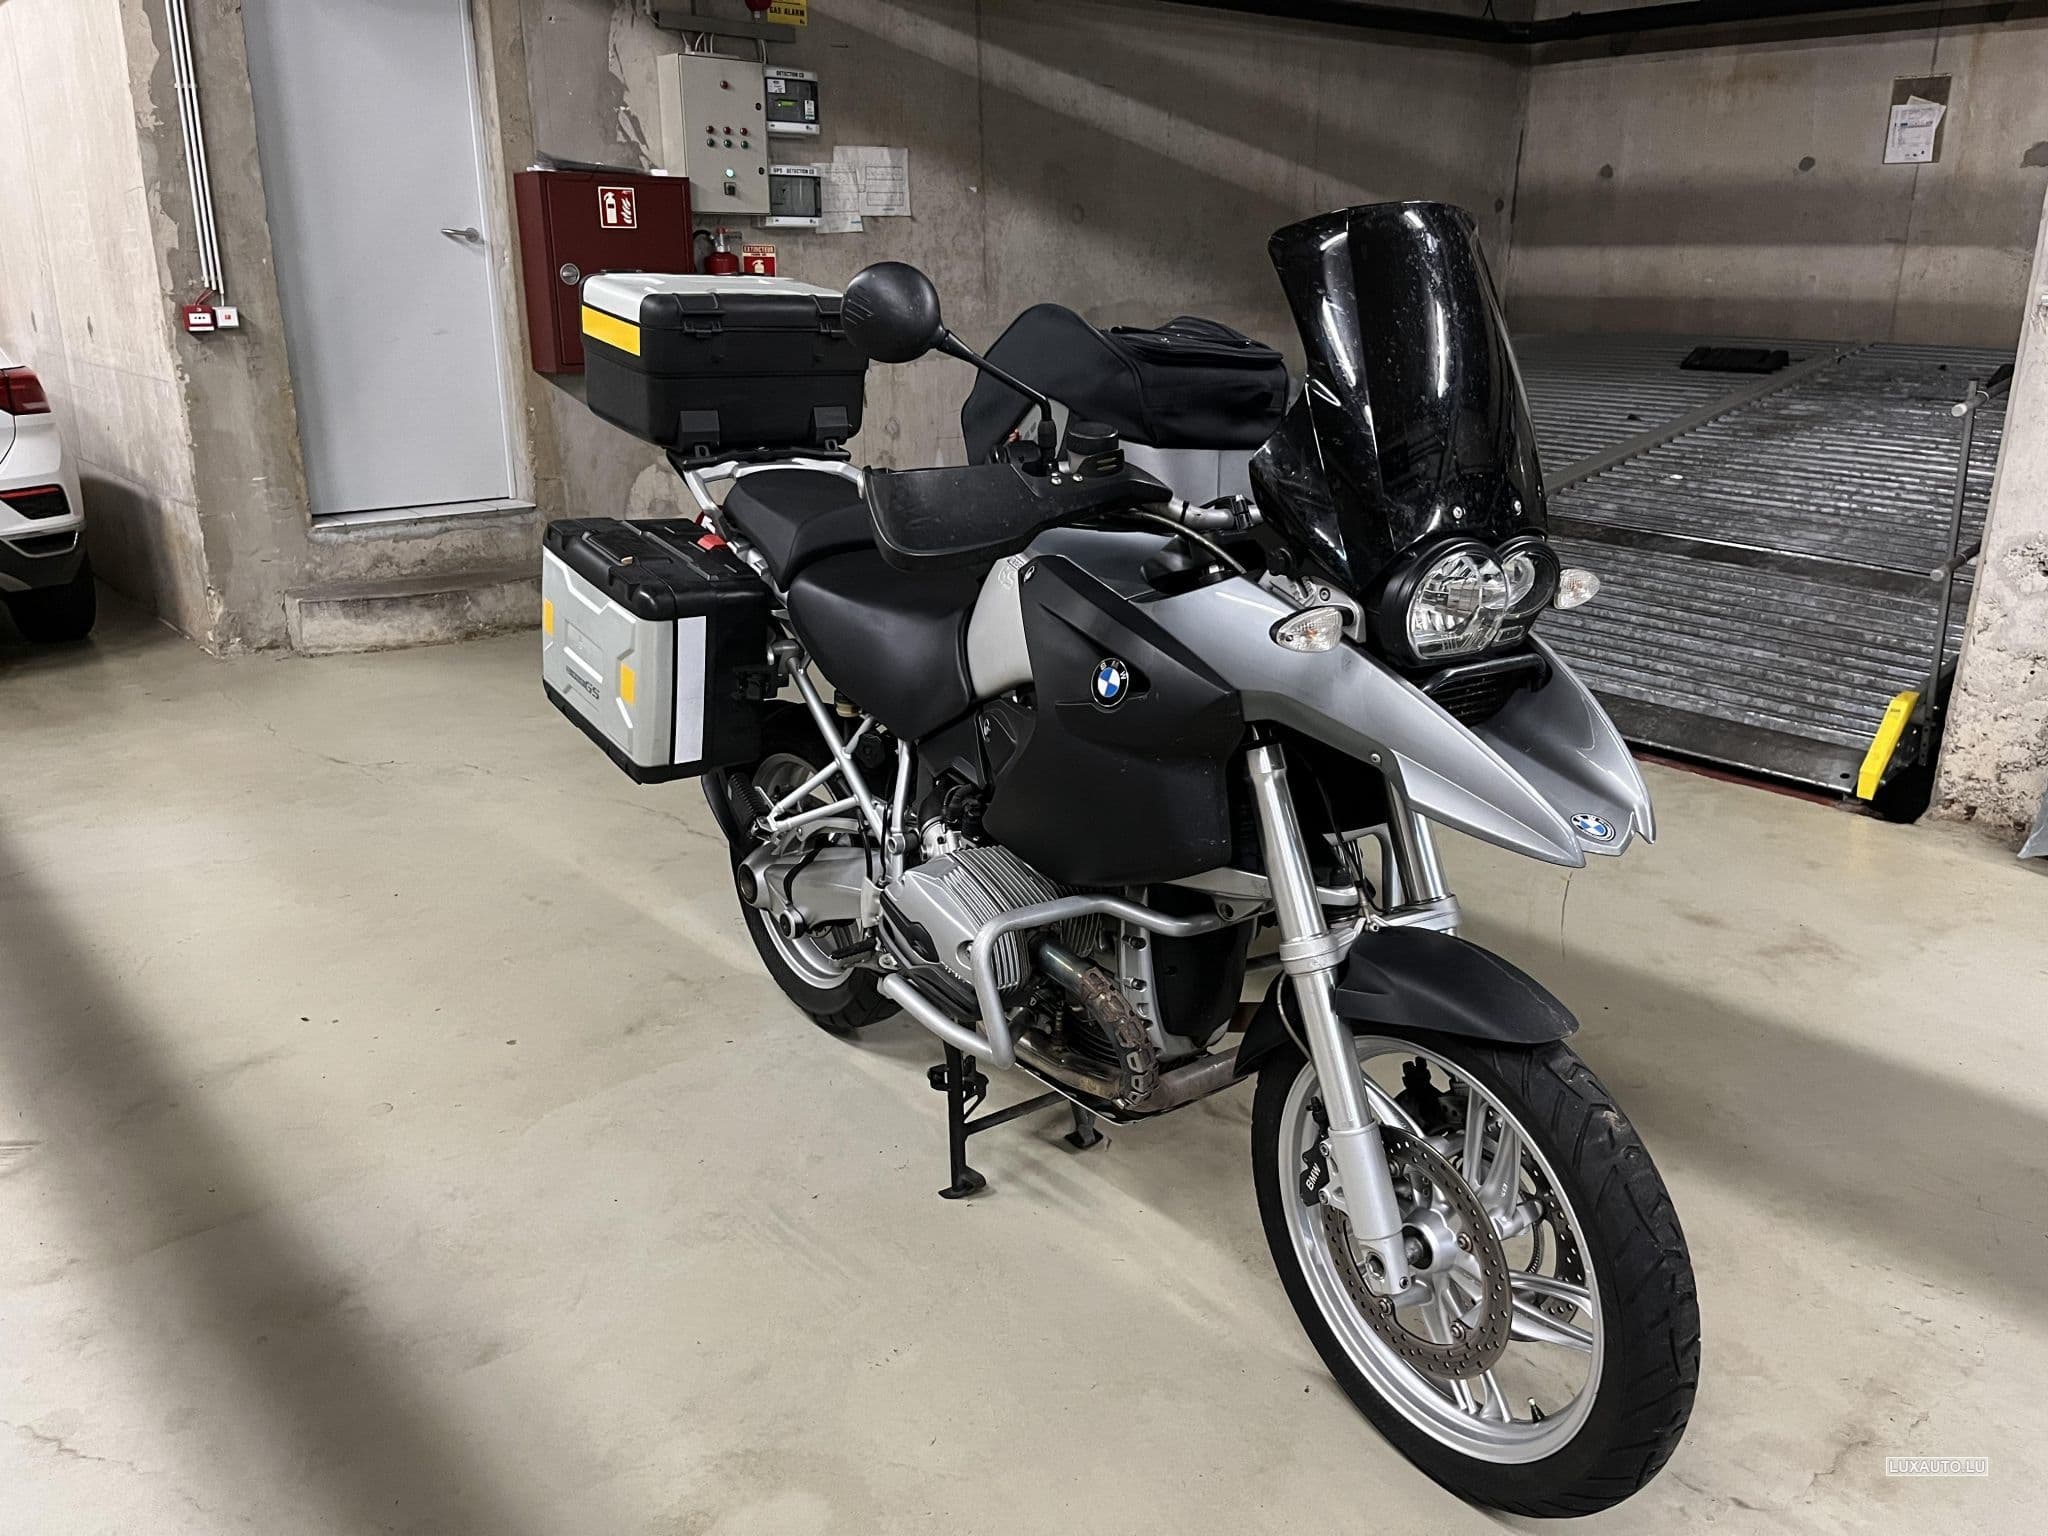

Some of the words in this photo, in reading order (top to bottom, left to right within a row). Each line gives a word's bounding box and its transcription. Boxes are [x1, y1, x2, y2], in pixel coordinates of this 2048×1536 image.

[769, 6, 781, 14] GAS
[784, 7, 805, 16] ALARM
[1100, 660, 1128, 680] BMW
[1305, 1162, 1321, 1191] BMW
